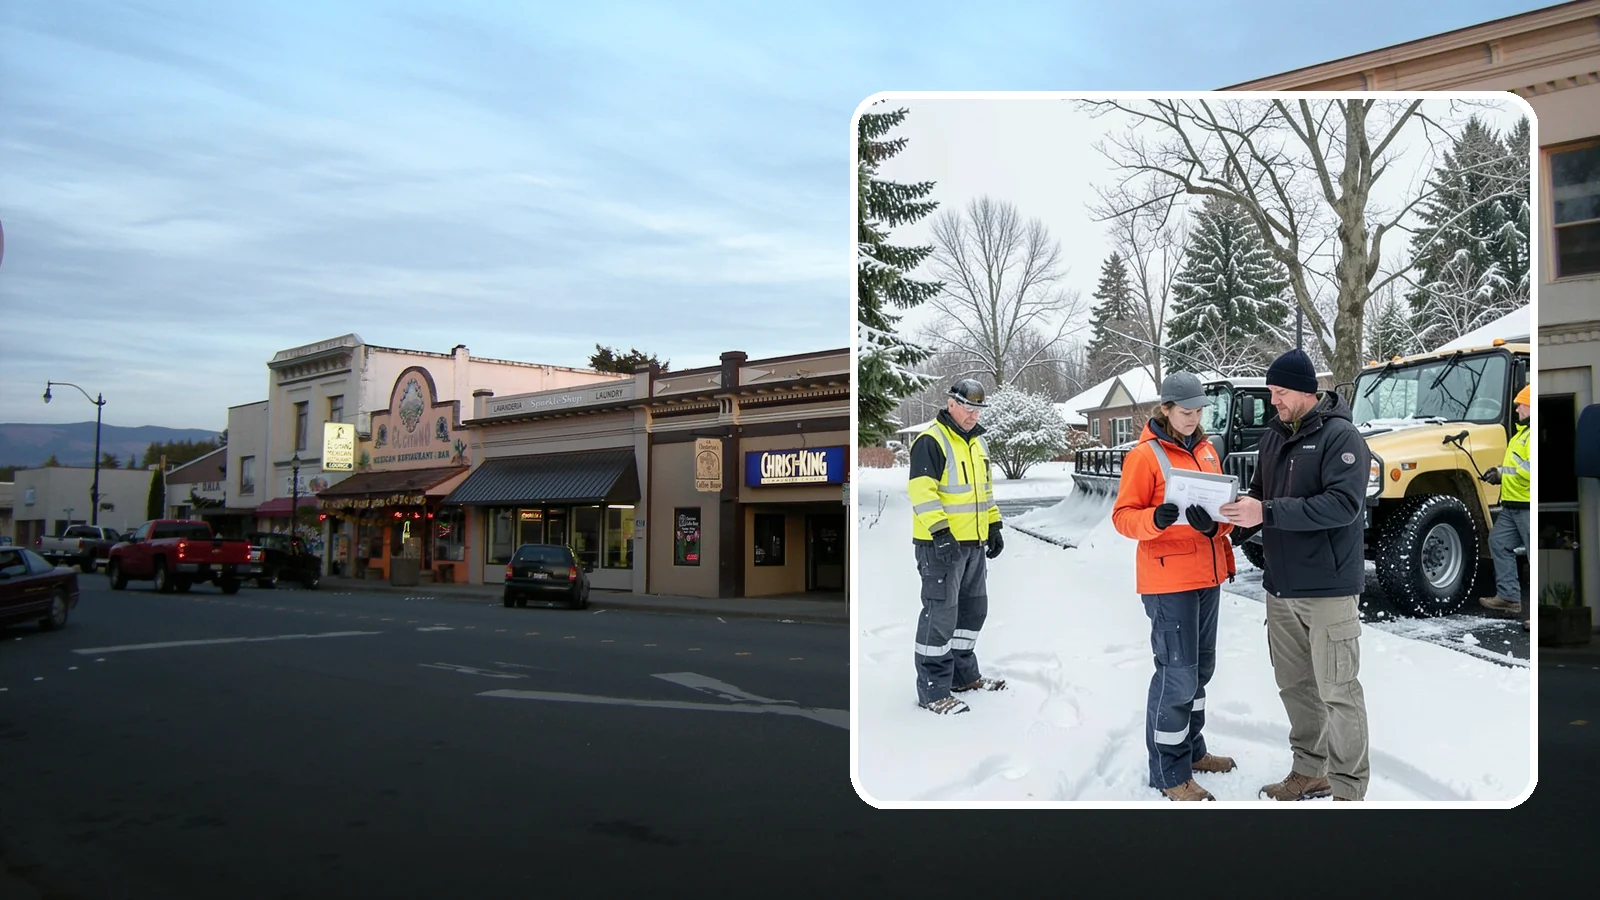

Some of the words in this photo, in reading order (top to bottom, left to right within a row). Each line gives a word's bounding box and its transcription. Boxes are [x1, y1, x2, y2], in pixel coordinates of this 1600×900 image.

[596, 389, 623, 399] LAUNDRY
[494, 402, 522, 412] LAVANDERIA
[530, 398, 560, 409] Sparkle
[562, 394, 582, 405] Shop
[374, 454, 396, 464] MEXICAN
[398, 451, 433, 462] RESTAURANT
[438, 450, 450, 459] BAR
[761, 452, 797, 477] CHRIST
[799, 450, 827, 476] KING
